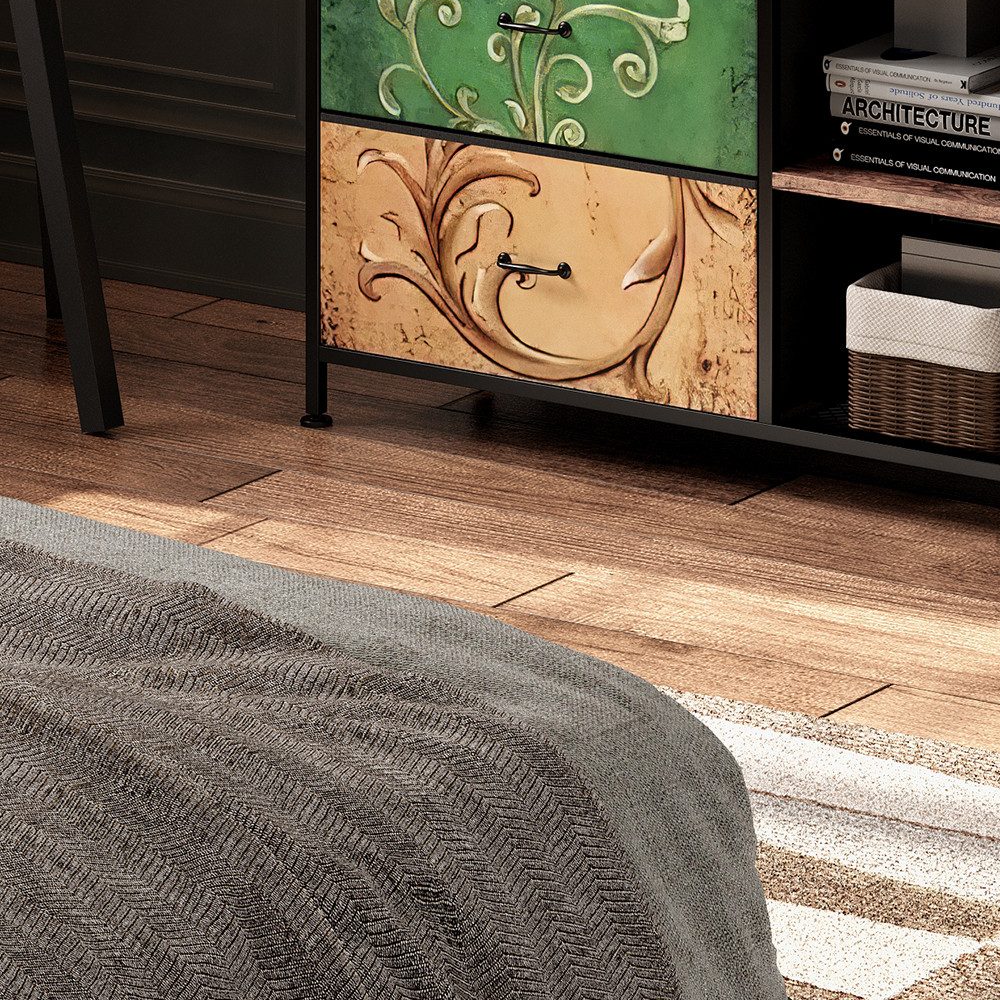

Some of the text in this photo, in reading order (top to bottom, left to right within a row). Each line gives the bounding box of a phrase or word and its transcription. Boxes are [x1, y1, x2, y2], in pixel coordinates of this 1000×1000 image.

[835, 62, 865, 74] ESSENTIALS
[872, 68, 889, 77] VISUAL
[889, 71, 932, 83] COMMUNICATION
[889, 87, 926, 100] Solitude
[928, 93, 939, 101] of
[941, 96, 965, 106] Years
[841, 96, 992, 137] ARCHITECTURE
[858, 126, 902, 140] ESSENTIALS
[902, 133, 913, 141] OF
[914, 135, 940, 146] VISUAL
[850, 153, 894, 167] ESSENTIALS
[894, 160, 906, 168] OF
[906, 162, 932, 173] VISUAL
[932, 166, 997, 183] COMMUNICATION
